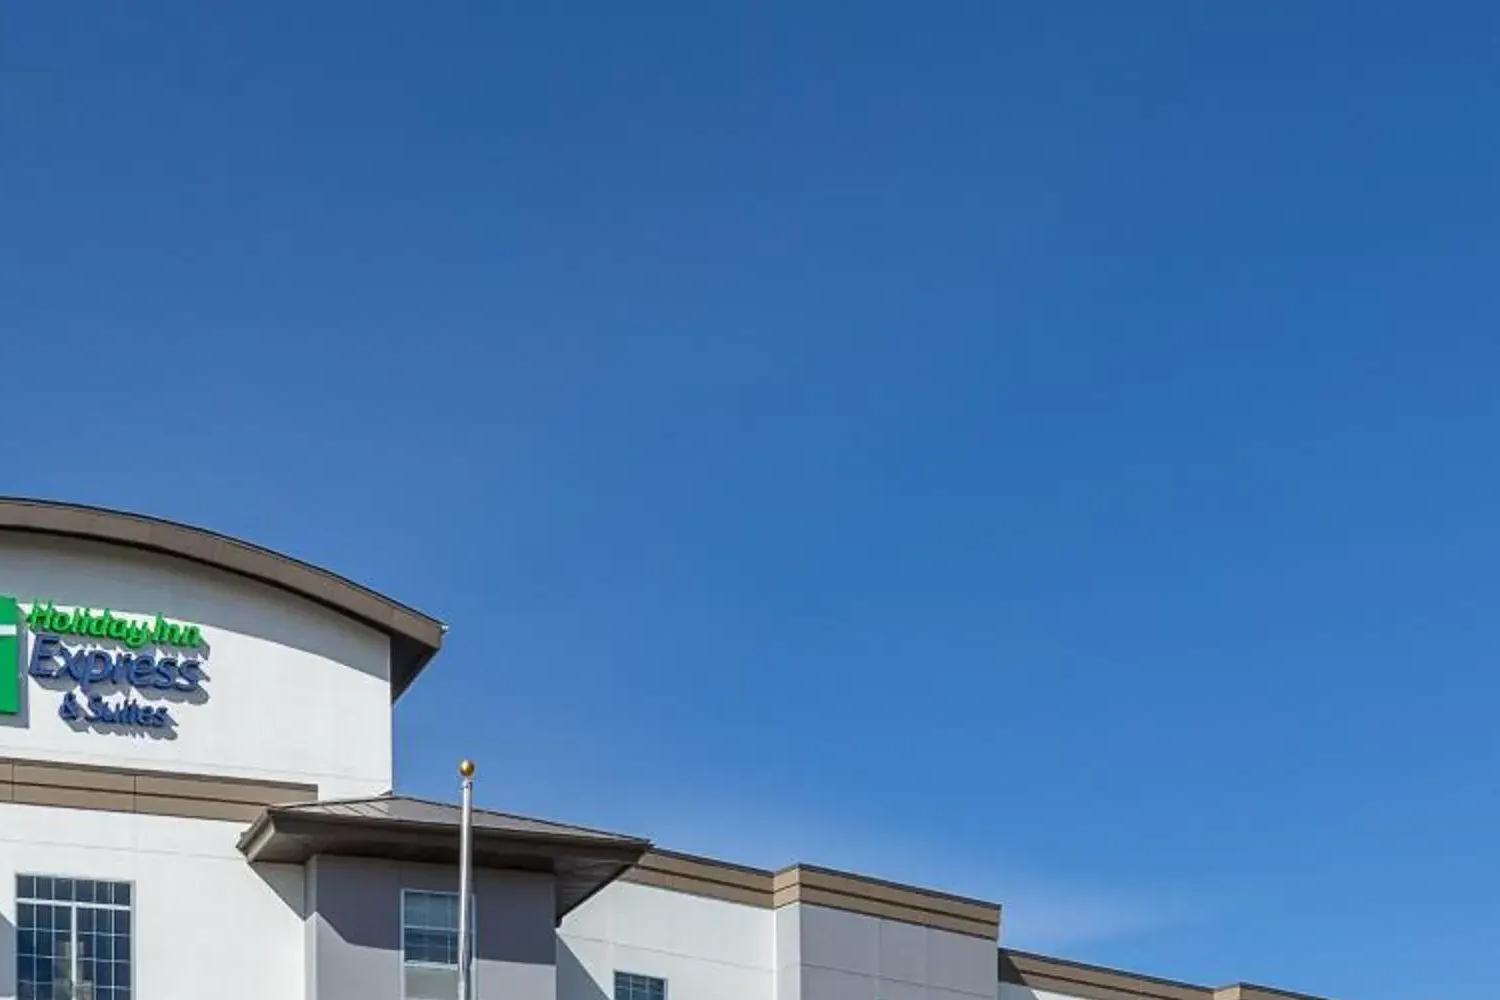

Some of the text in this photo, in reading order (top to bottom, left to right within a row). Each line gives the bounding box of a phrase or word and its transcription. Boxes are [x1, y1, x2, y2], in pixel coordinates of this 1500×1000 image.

[27, 599, 201, 648] Holiday Inn
[29, 633, 202, 693] Express
[58, 691, 169, 727] & Suites
